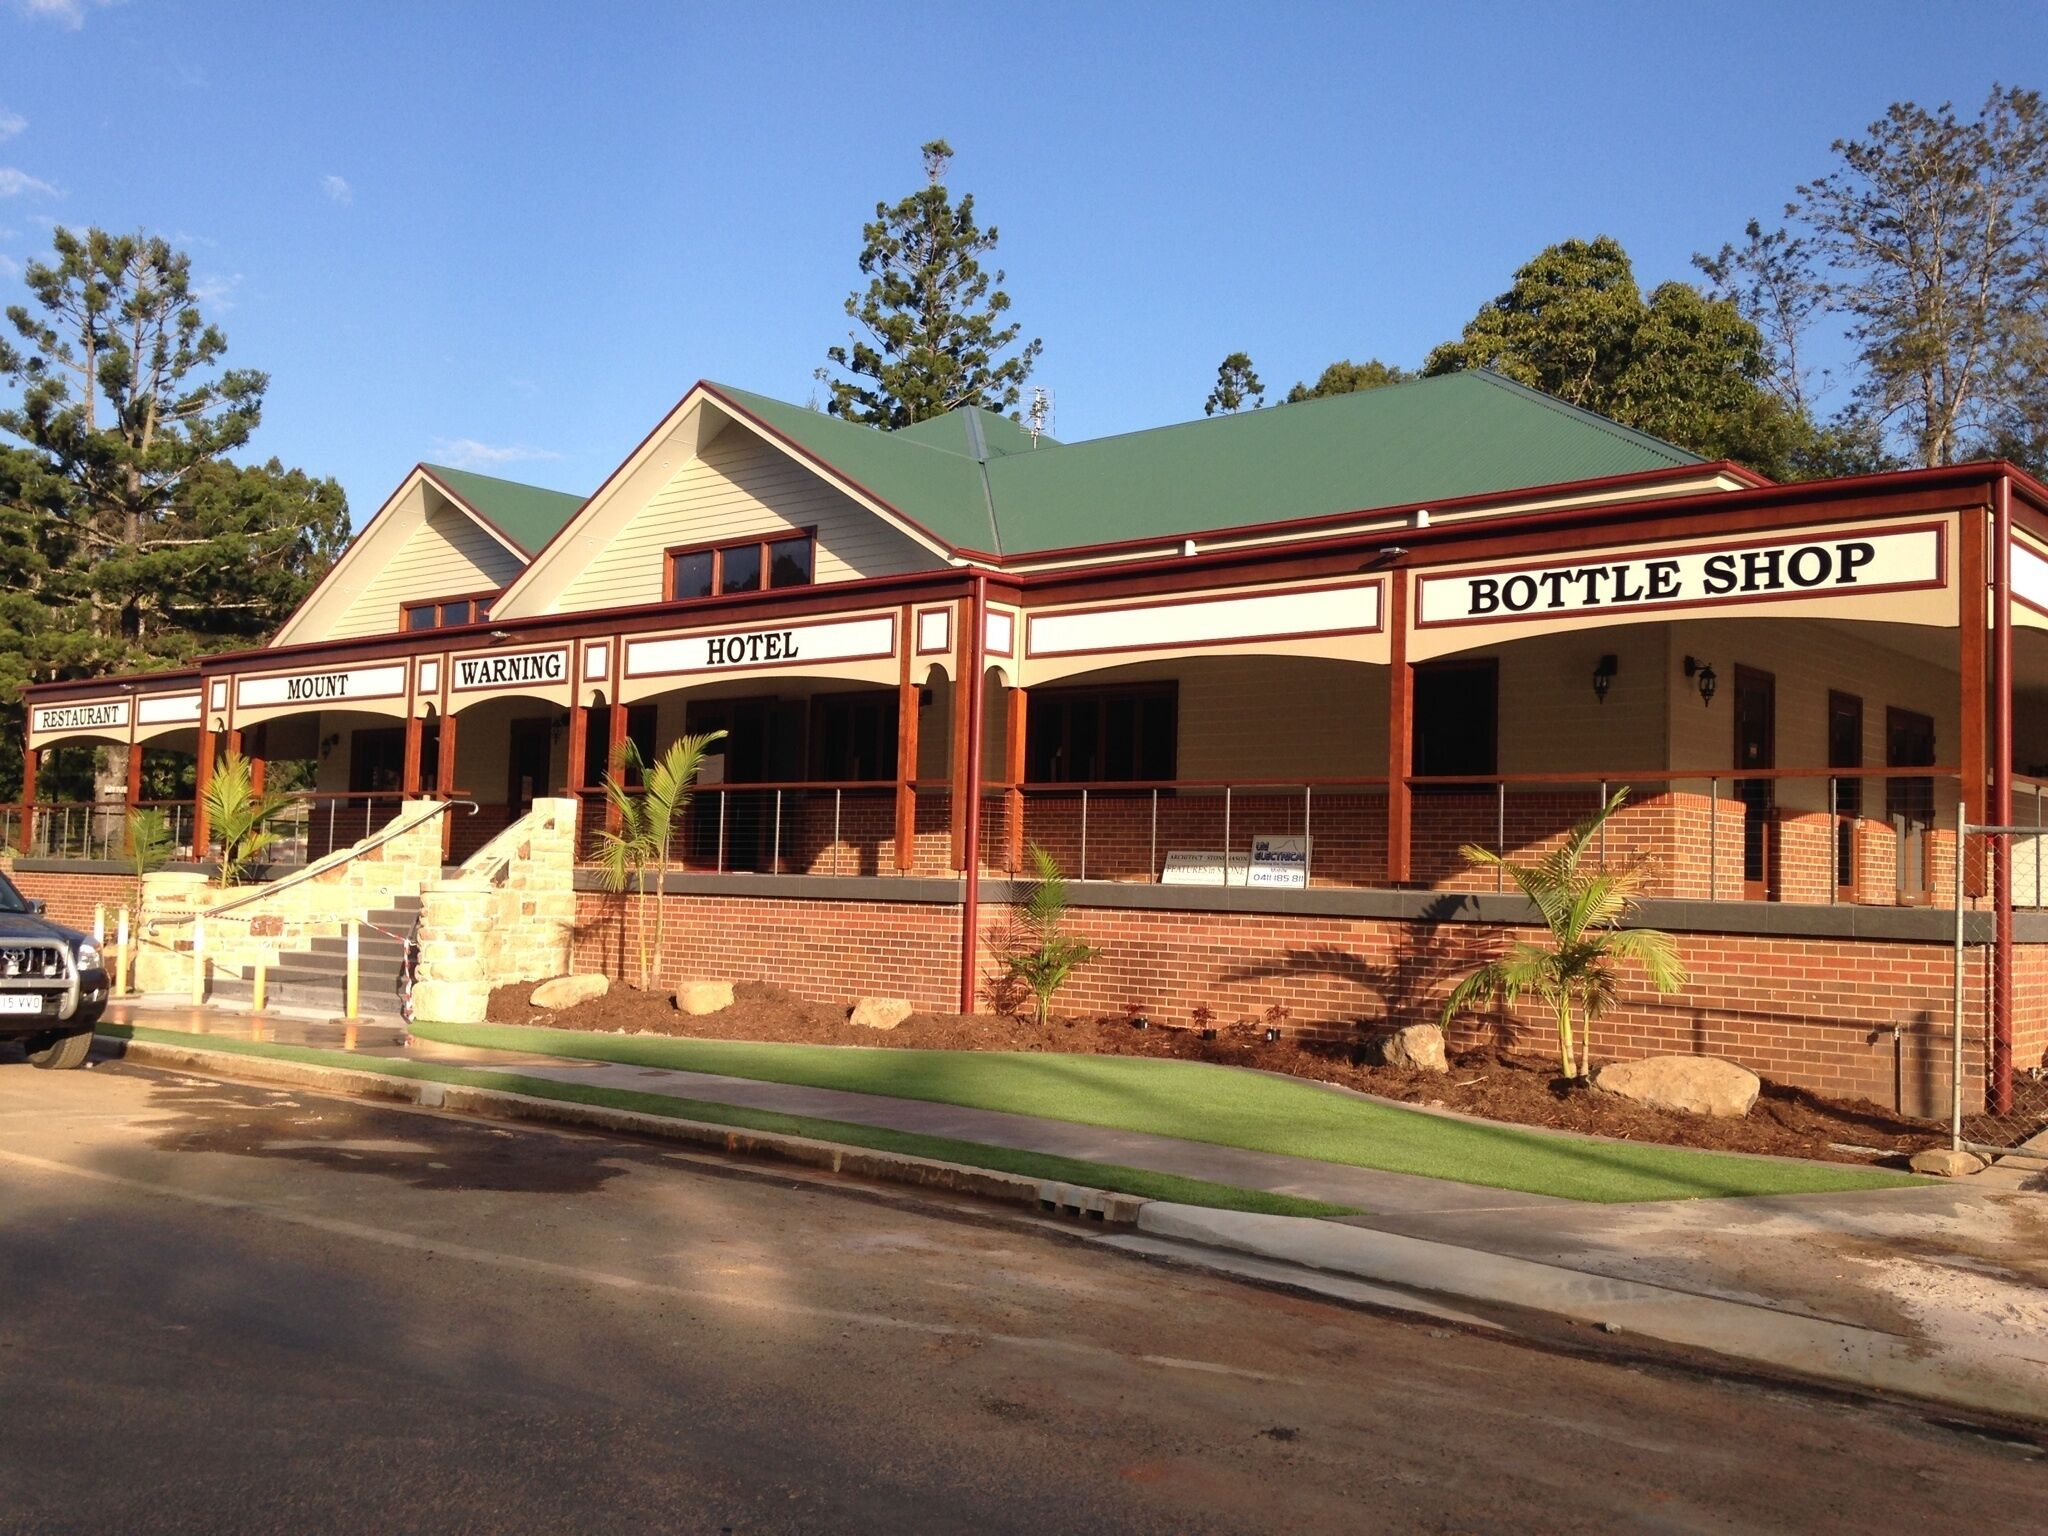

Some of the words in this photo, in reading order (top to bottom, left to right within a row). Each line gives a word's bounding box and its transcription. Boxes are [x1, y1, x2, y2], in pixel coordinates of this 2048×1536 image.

[1467, 560, 1682, 615] BOTTLE
[1702, 542, 1876, 595] SHOP
[706, 631, 799, 665] HOTEL
[461, 654, 561, 685] WARNING
[287, 674, 349, 700] MOUNT
[42, 705, 120, 728] RESTAURANT
[1166, 865, 1208, 874] FEATURES
[1217, 866, 1246, 876] SONE
[1274, 874, 1290, 882] 185
